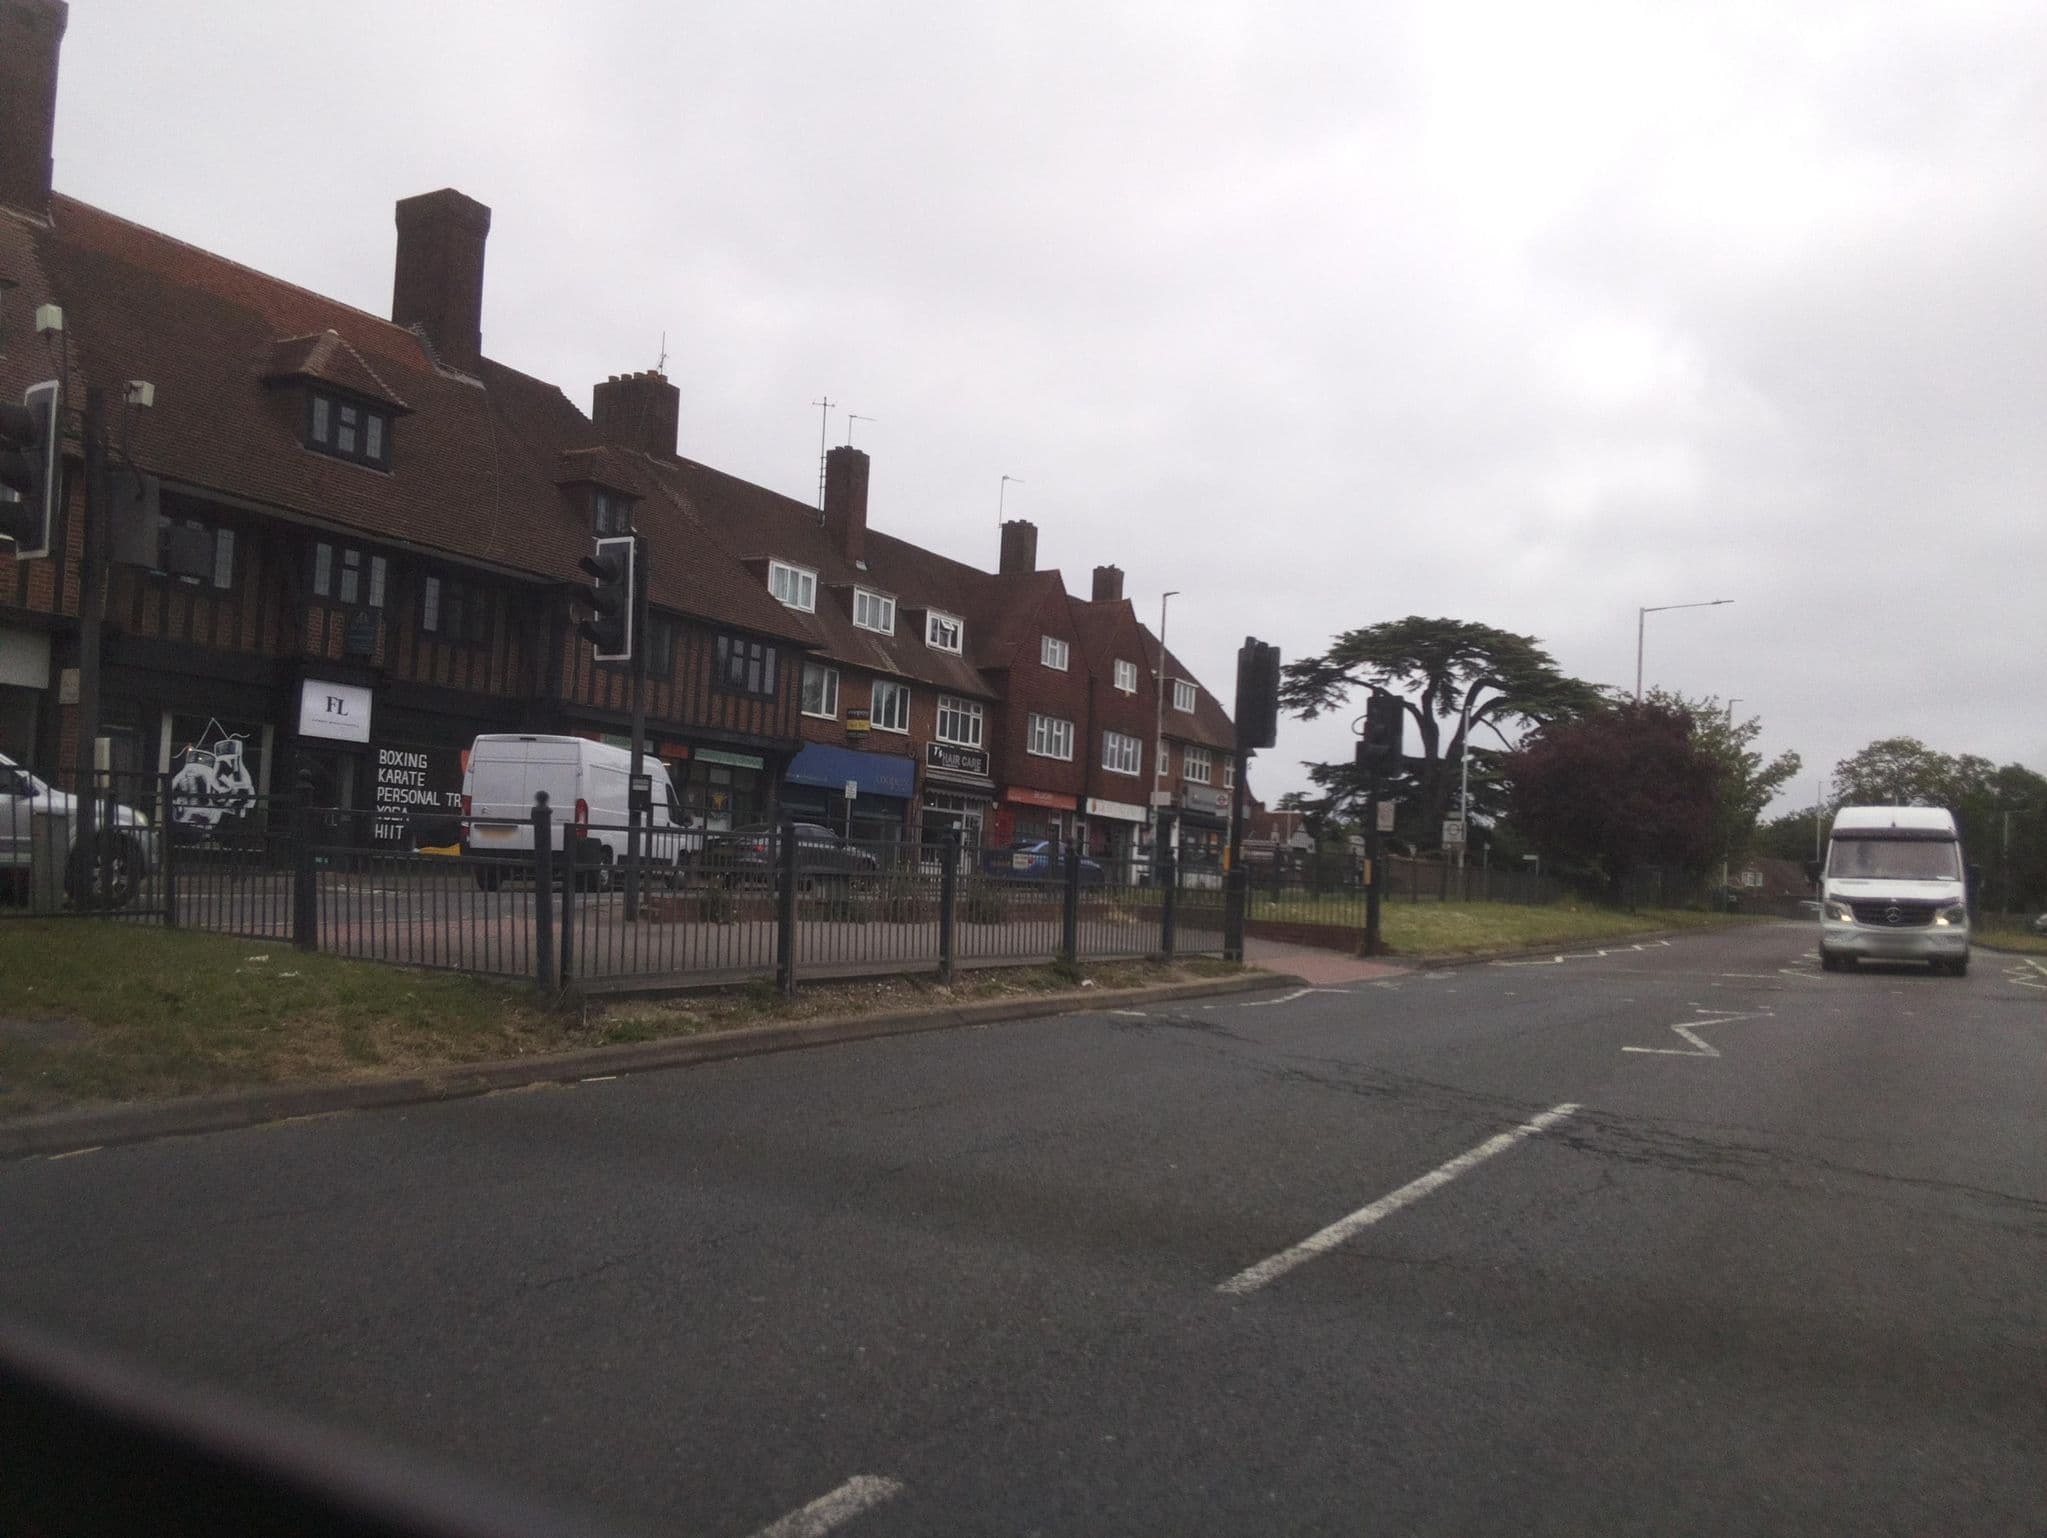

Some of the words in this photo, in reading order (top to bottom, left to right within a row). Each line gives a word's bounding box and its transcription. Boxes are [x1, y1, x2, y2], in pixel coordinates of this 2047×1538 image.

[326, 695, 349, 716] FL
[379, 749, 428, 769] BOXING
[942, 752, 960, 765] HAIR
[961, 756, 982, 769] CARE
[378, 768, 427, 787] KARATE
[377, 786, 440, 806] PERSONAL
[374, 823, 404, 840] HIIT
